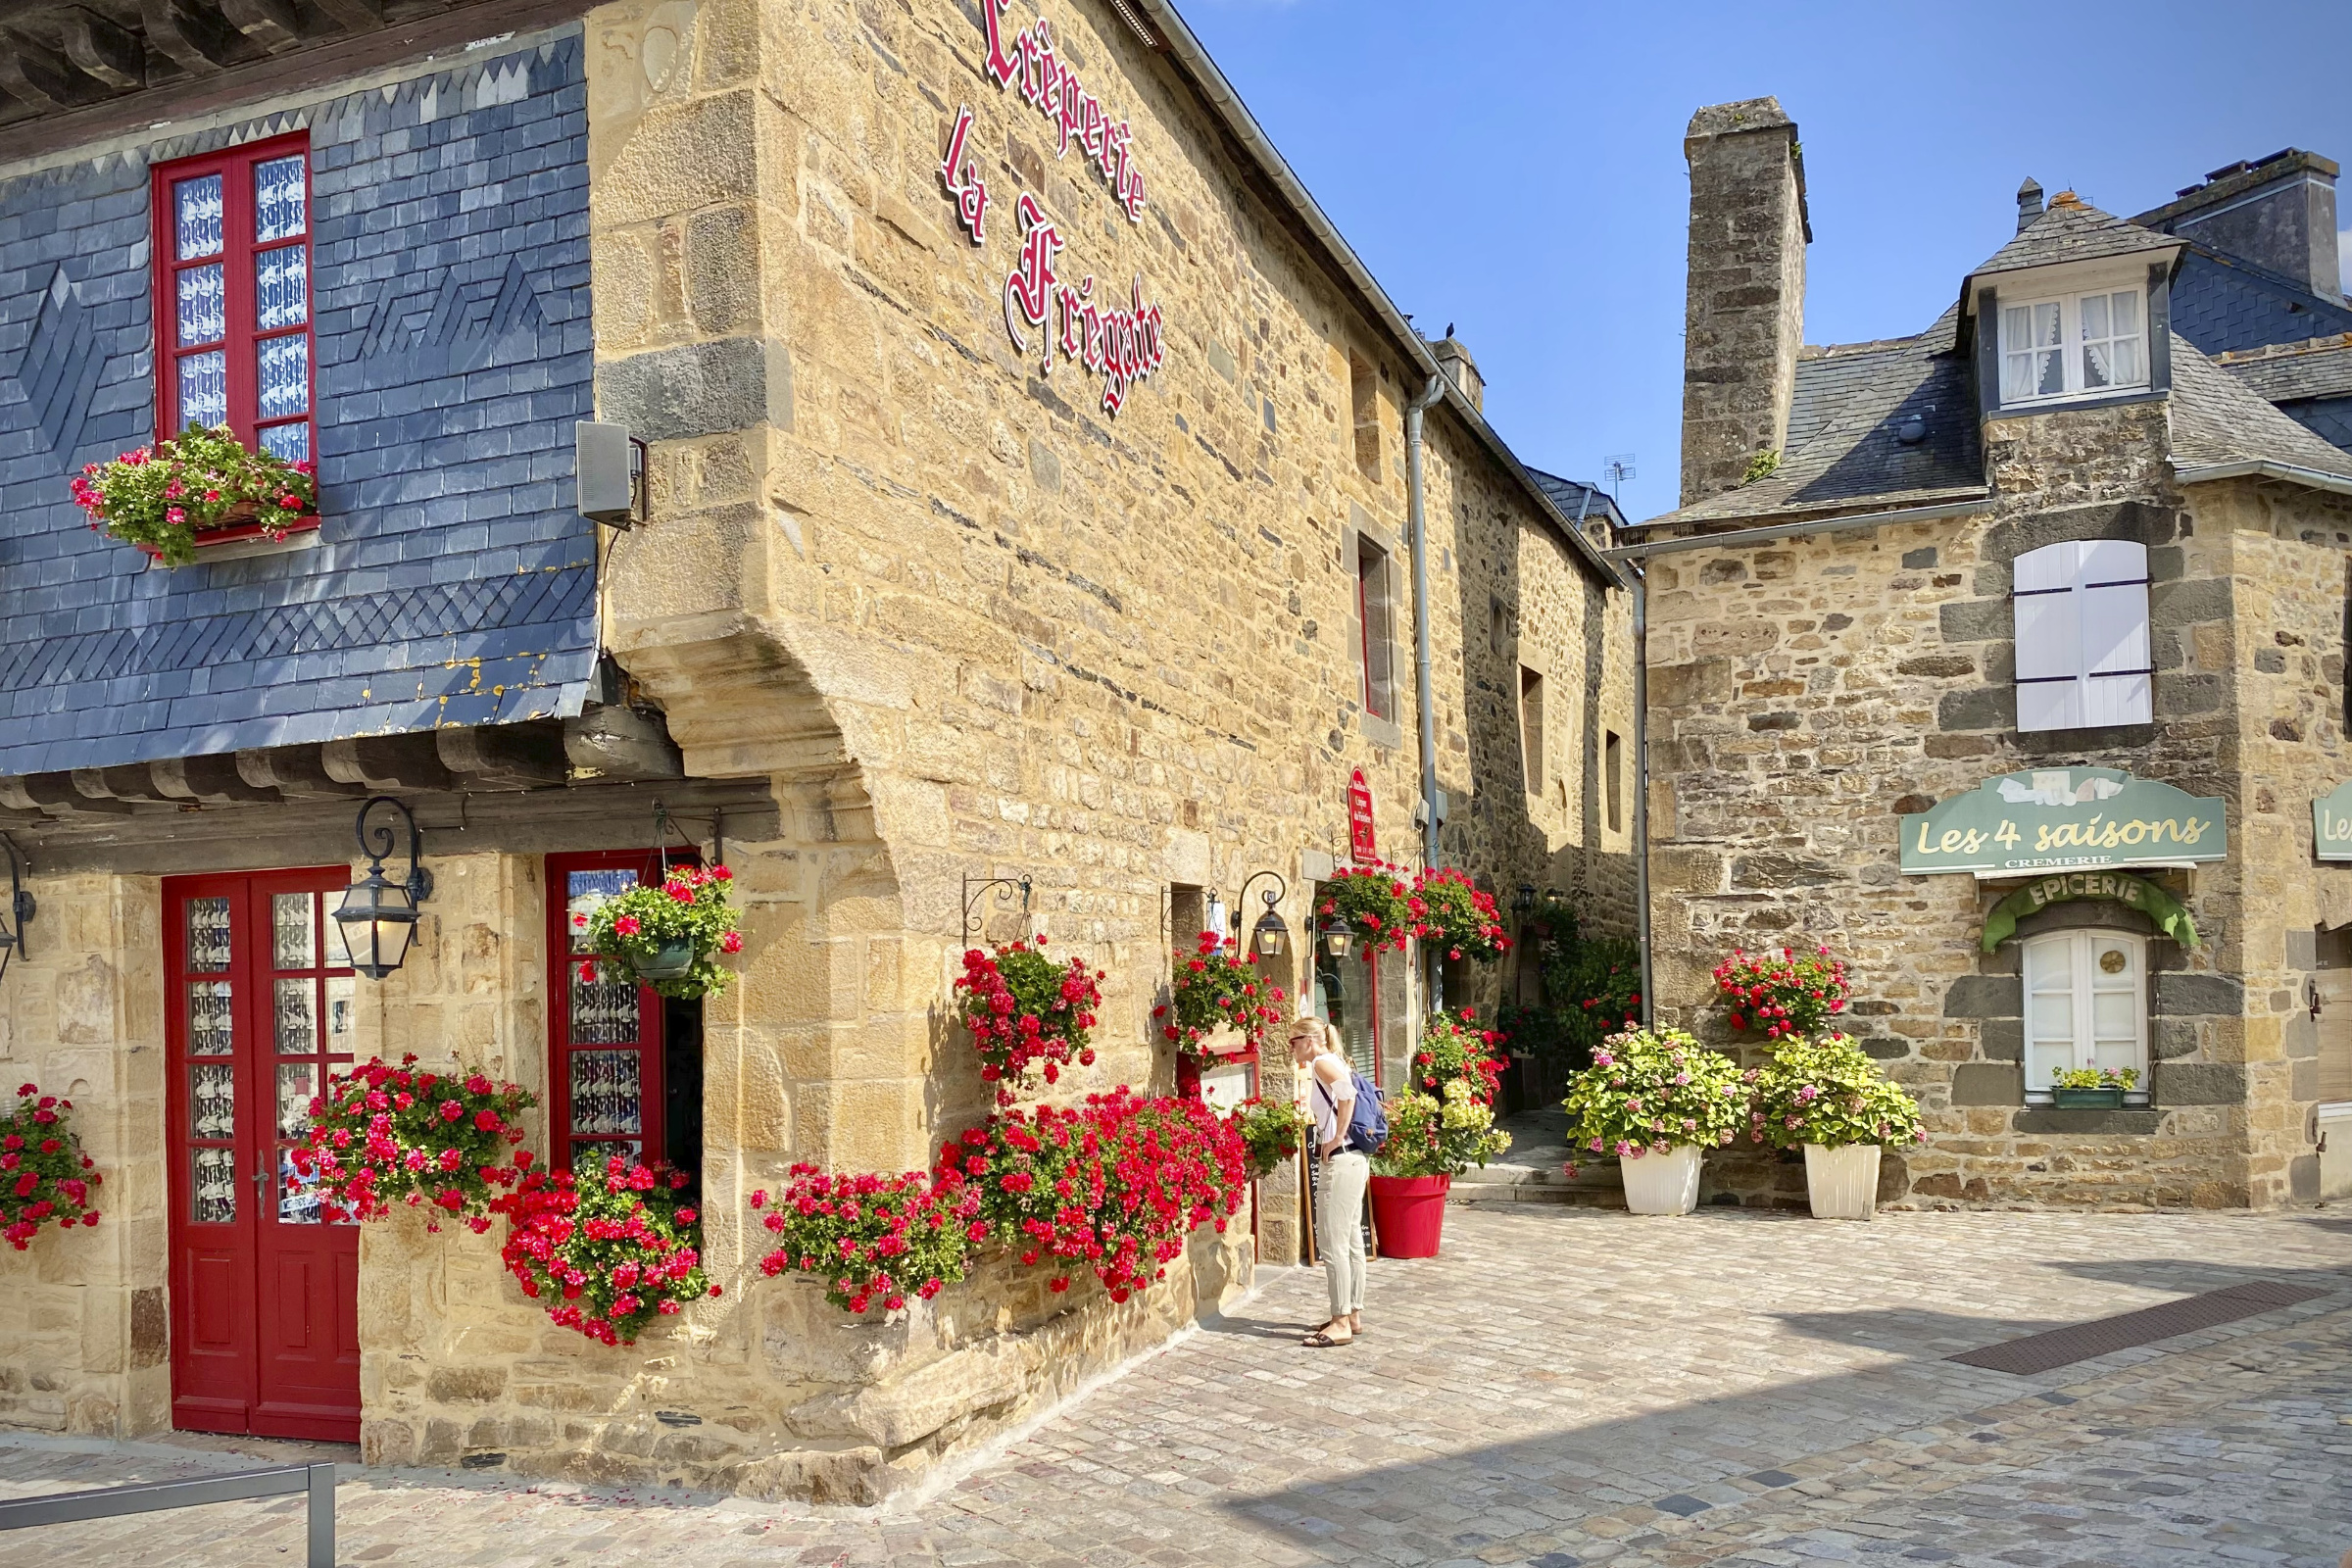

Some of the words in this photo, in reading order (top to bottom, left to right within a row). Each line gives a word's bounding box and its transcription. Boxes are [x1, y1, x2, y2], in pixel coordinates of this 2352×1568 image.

[1004, 191, 1165, 416] Frégate
[1918, 821, 1988, 855] Les
[1994, 819, 2021, 851] 4
[2034, 812, 2211, 852] saisons
[2325, 808, 2352, 843] Le
[2005, 855, 2114, 869] CREMERIE
[2029, 873, 2142, 906] EPICERIE
